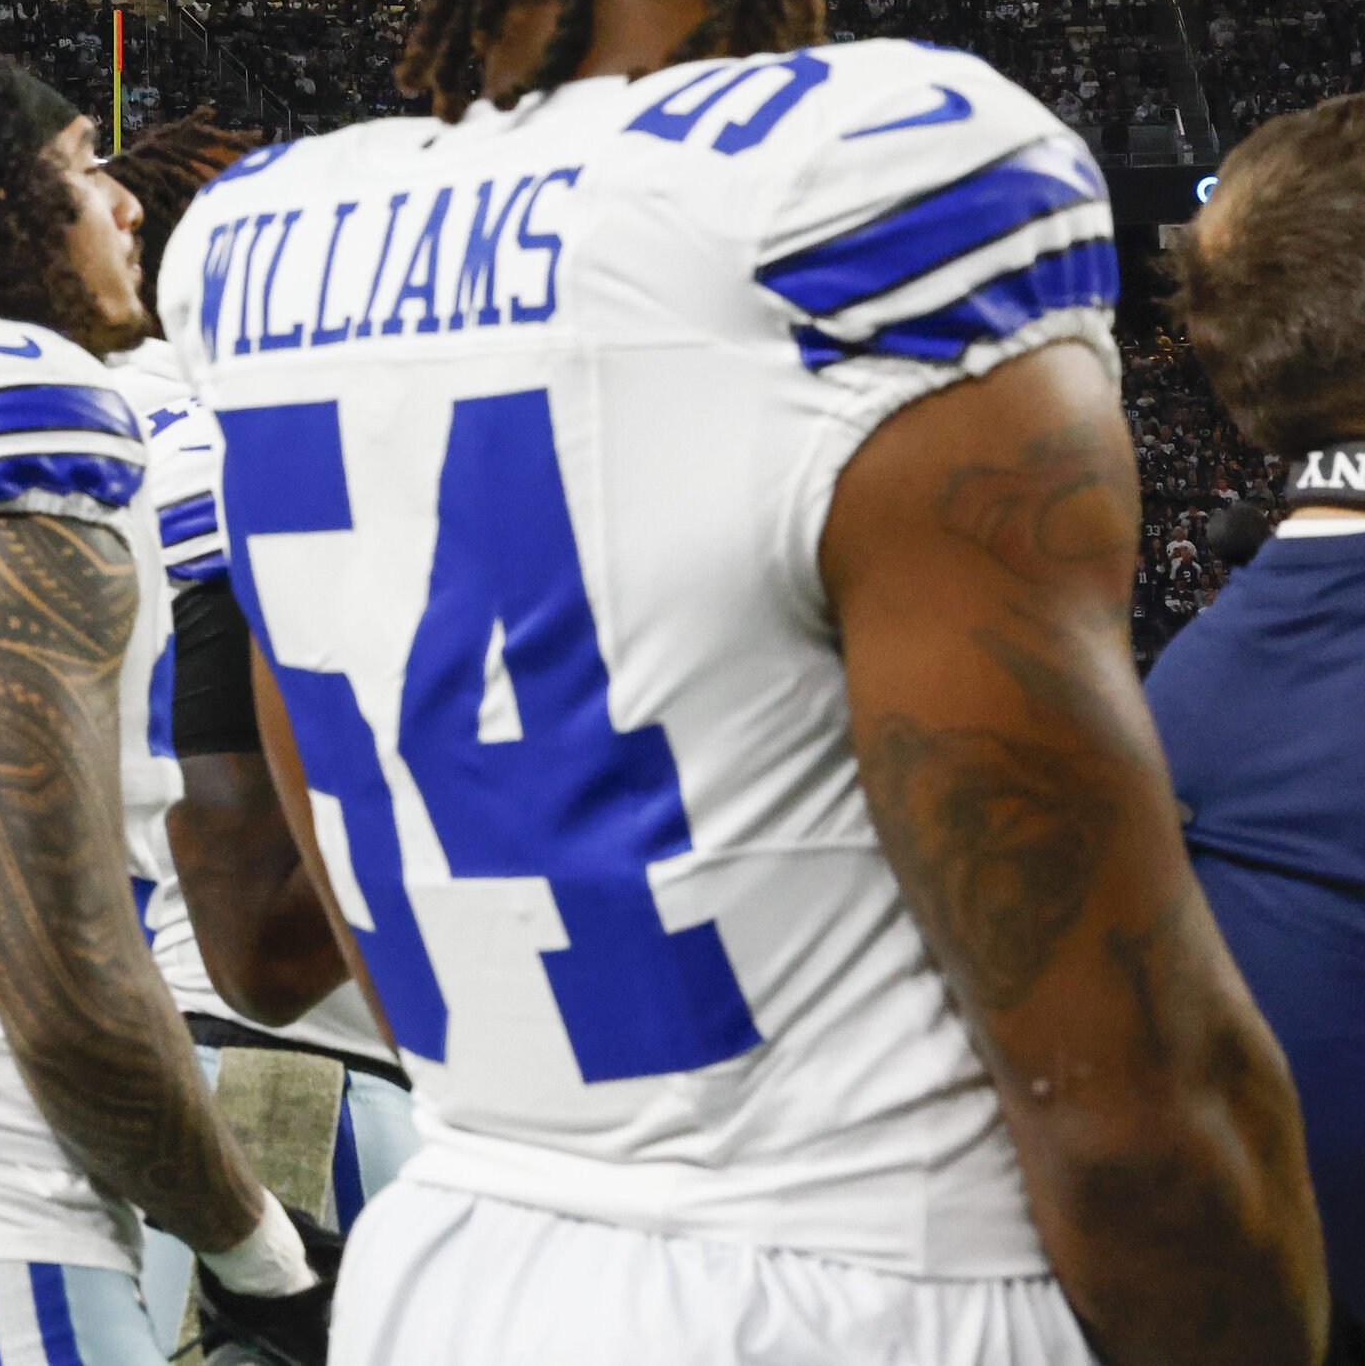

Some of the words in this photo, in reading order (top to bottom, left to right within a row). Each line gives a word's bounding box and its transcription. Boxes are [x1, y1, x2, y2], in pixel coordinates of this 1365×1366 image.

[199, 164, 586, 365] WILLIAMS
[1146, 525, 1160, 536] 33
[213, 386, 765, 1086] 54
